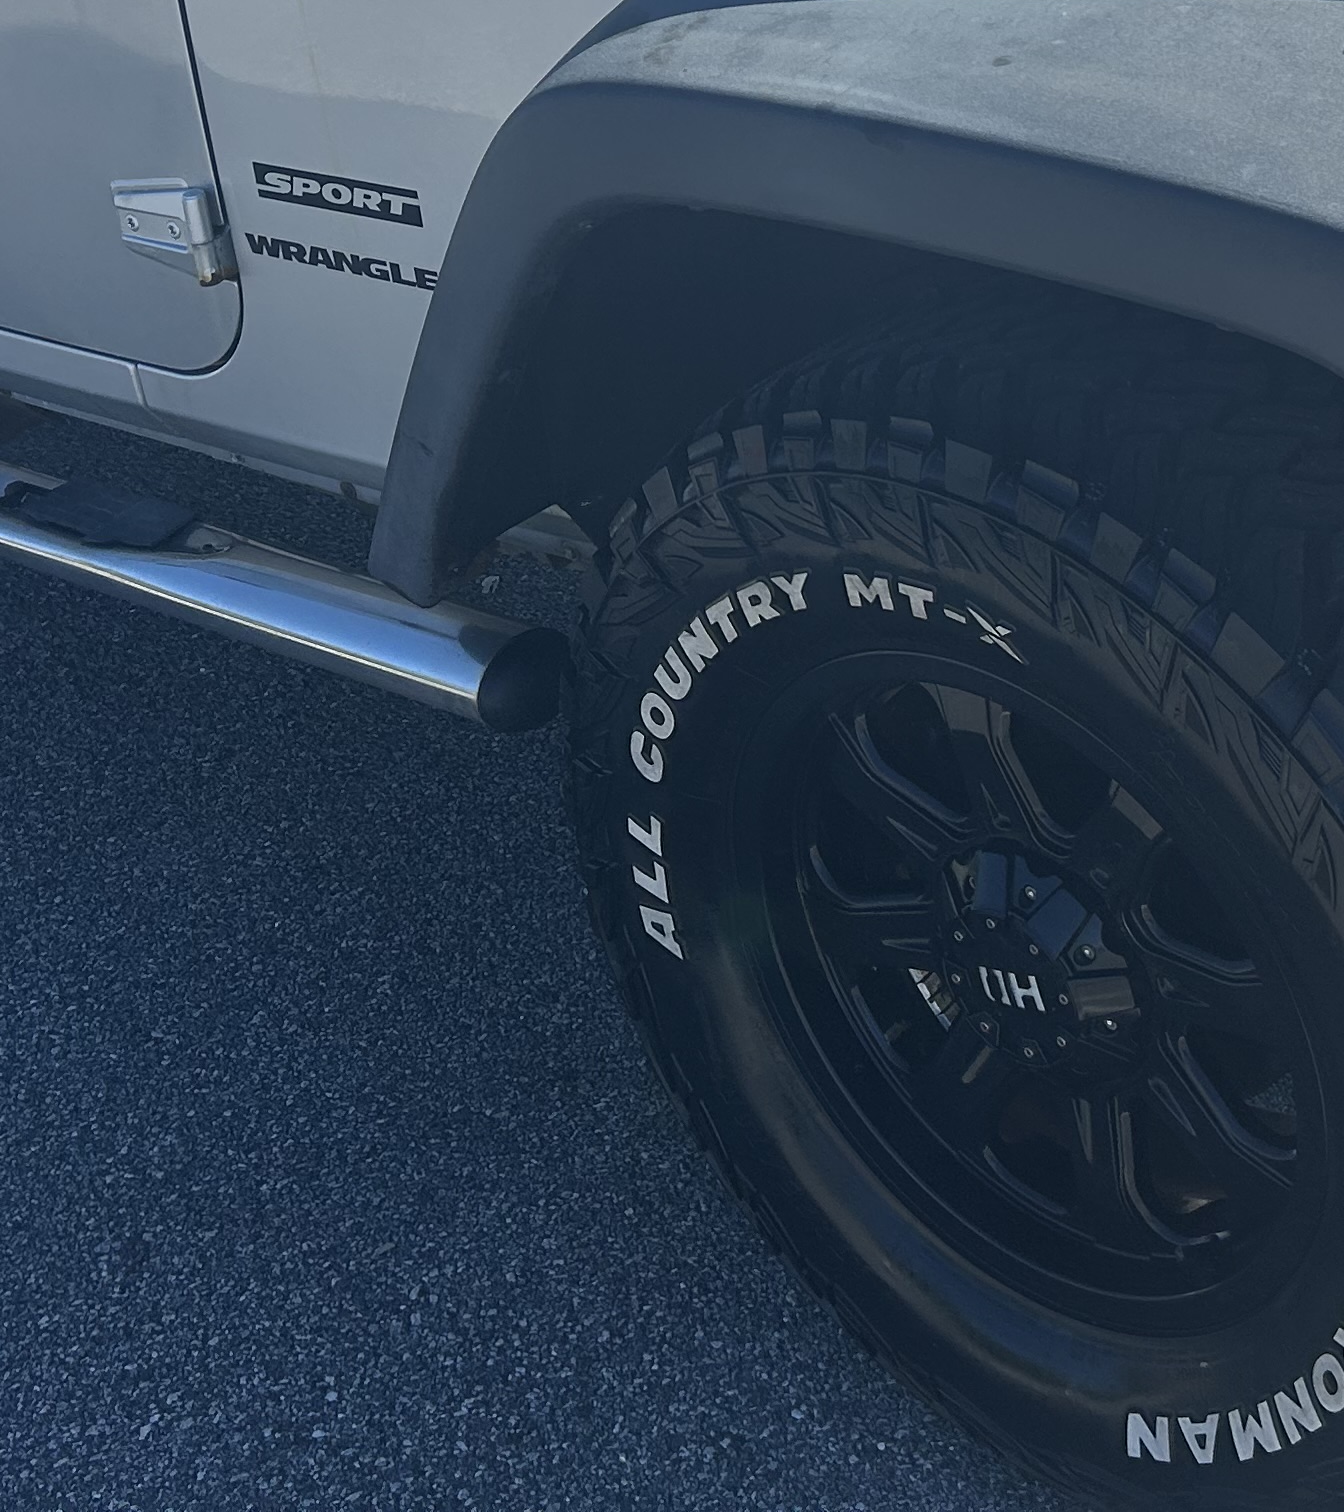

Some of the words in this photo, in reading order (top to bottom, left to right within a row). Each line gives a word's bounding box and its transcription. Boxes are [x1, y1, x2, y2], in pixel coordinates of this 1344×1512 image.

[256, 171, 419, 216] SPORT
[629, 572, 808, 782] COUNTRY
[843, 572, 1026, 665] MT-X
[627, 813, 685, 960] ALL
